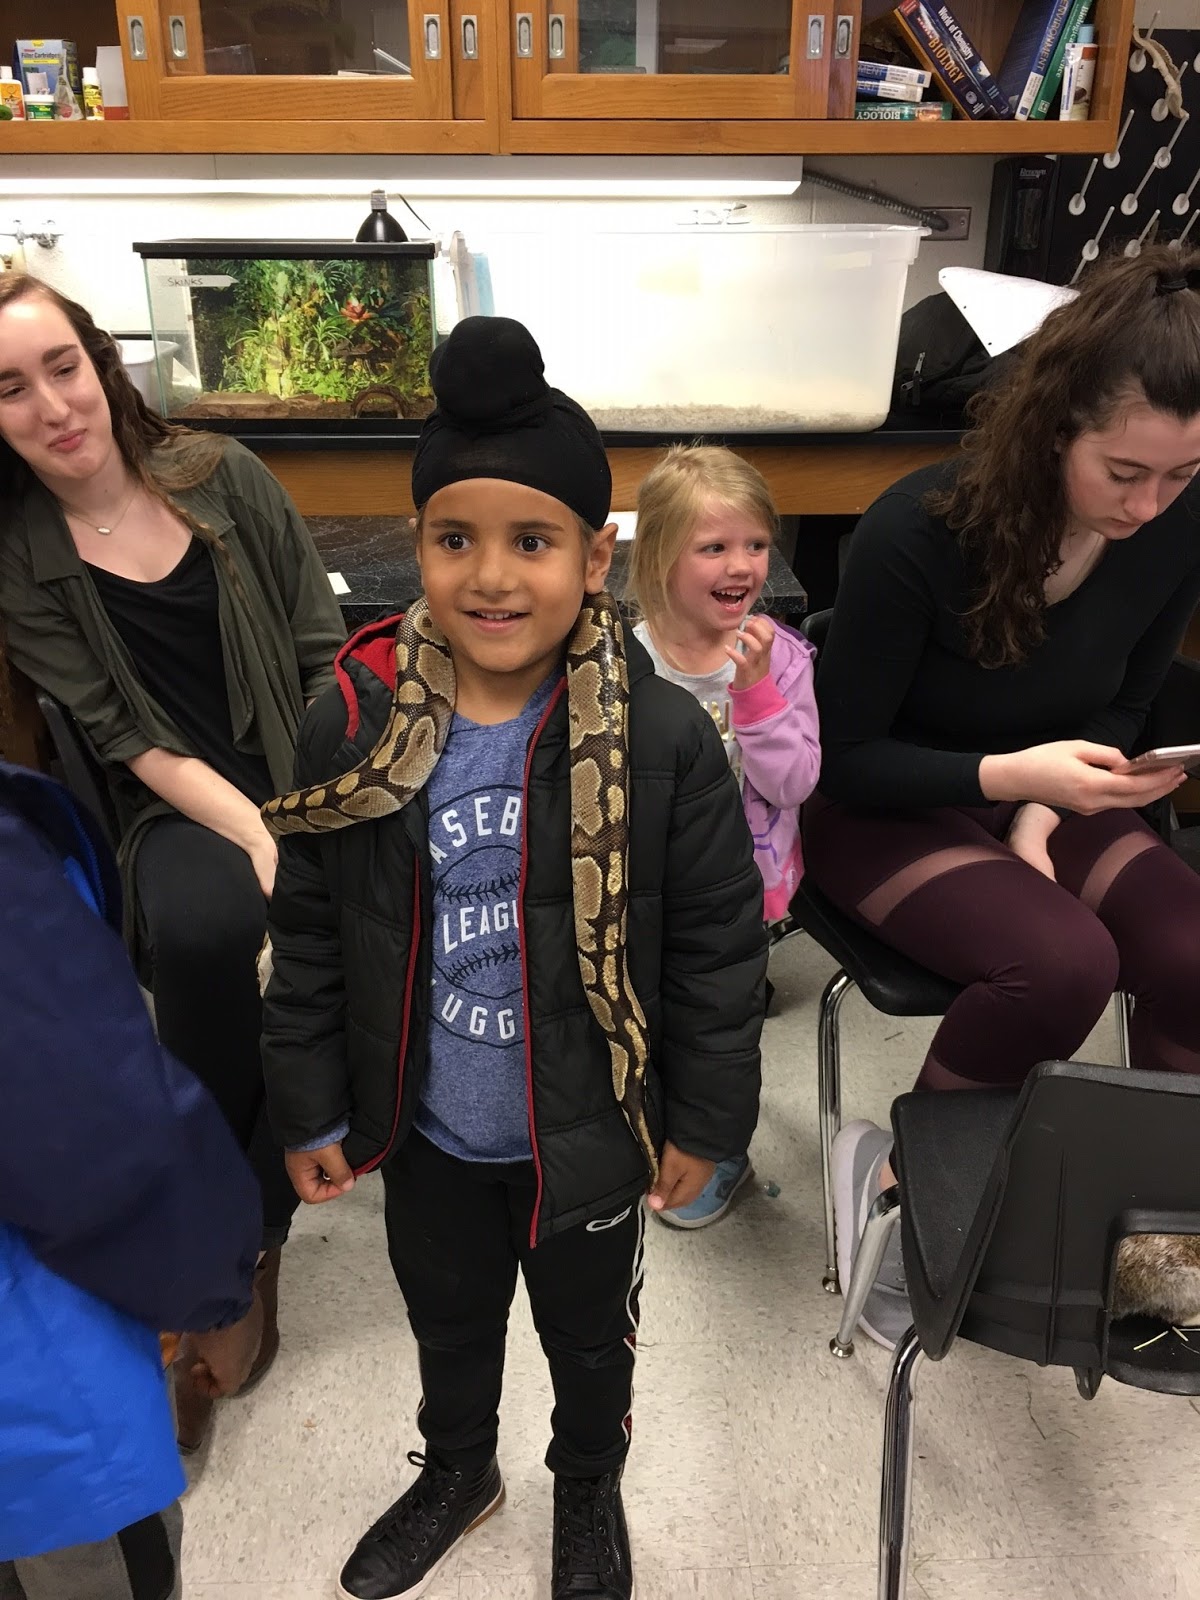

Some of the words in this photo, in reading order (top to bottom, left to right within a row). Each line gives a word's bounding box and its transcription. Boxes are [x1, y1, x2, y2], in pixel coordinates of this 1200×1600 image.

[938, 6, 954, 27] World
[948, 24, 959, 33] of
[1069, 5, 1089, 43] Biologica
[928, 37, 965, 83] BIOLOGY
[953, 30, 974, 60] Chemistry
[857, 111, 900, 120] BIOLOGY
[429, 796, 521, 865] ASEB
[441, 993, 516, 1040] UGG
